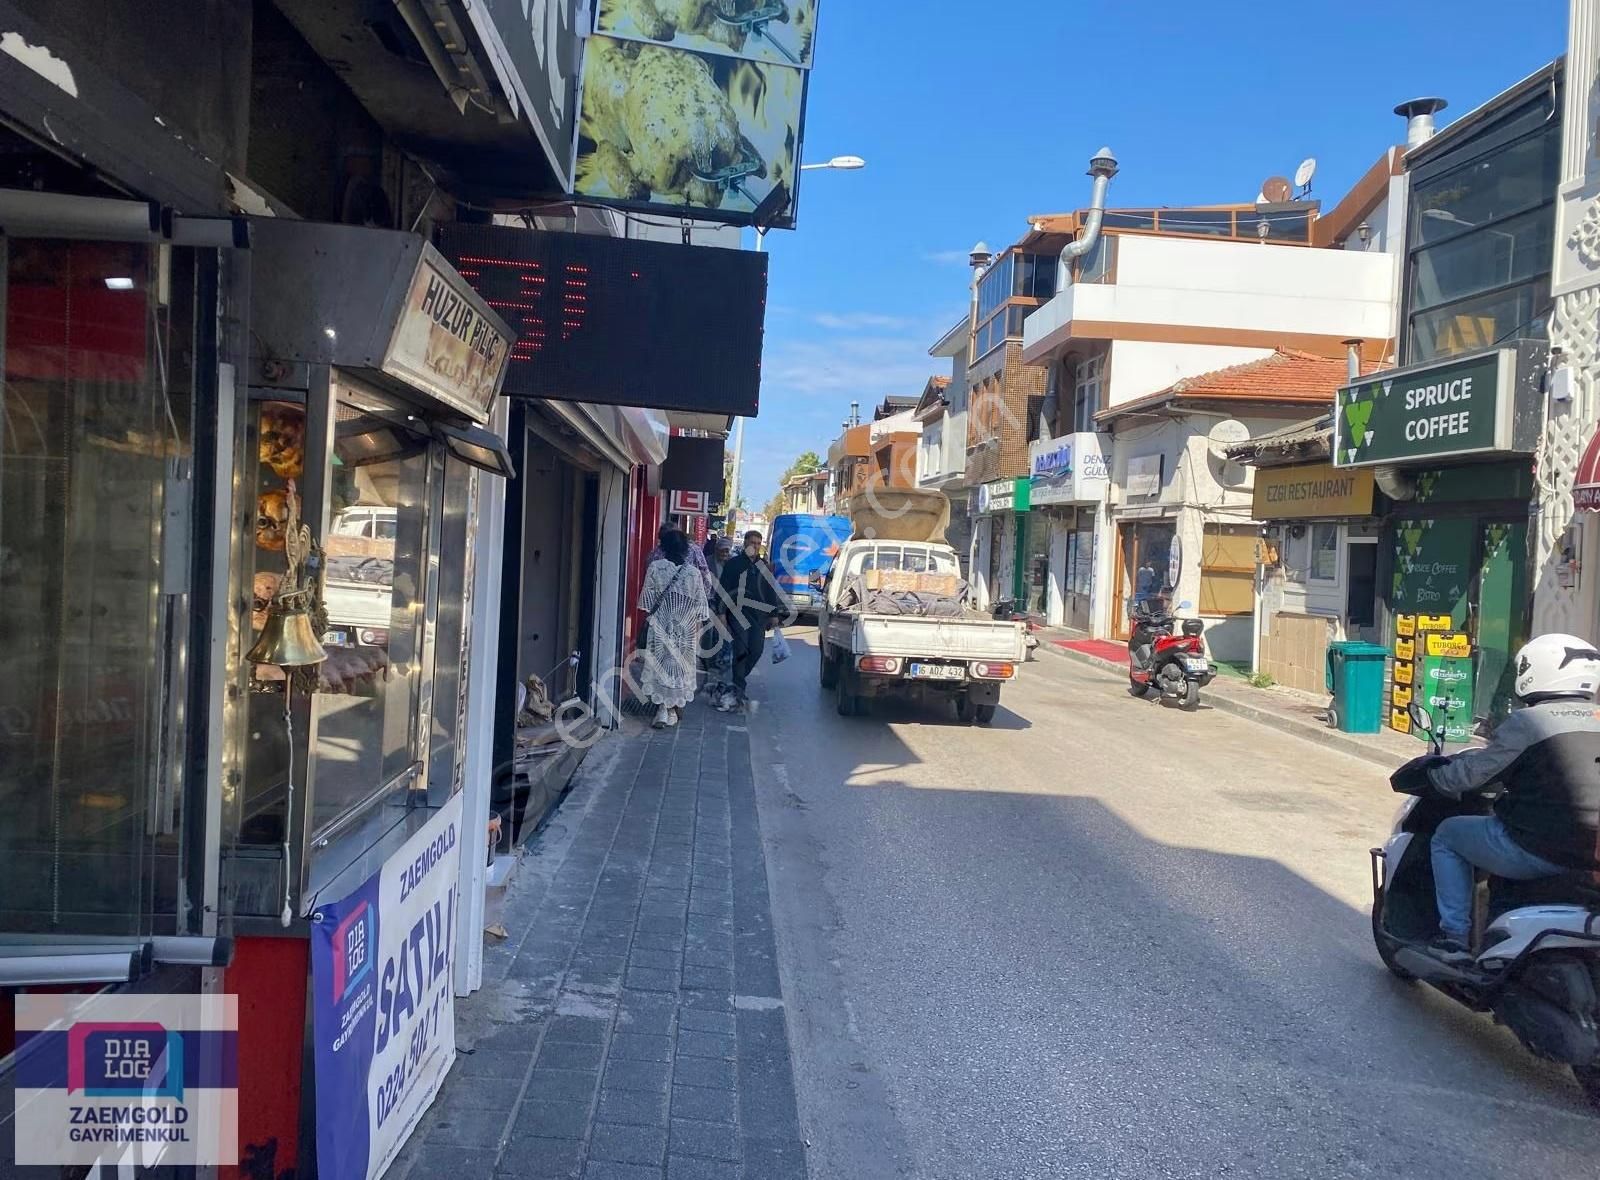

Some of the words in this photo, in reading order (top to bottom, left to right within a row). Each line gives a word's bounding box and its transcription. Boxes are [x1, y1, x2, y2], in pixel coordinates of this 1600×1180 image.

[421, 274, 474, 343] HUZUR
[1405, 377, 1473, 411] SPRUCE
[1405, 411, 1470, 442] COFFEE
[1289, 478, 1355, 501] RESTAURANT
[399, 822, 456, 904] ZAEMGOLD
[377, 1053, 407, 1130] 0224
[408, 1007, 431, 1078] 502
